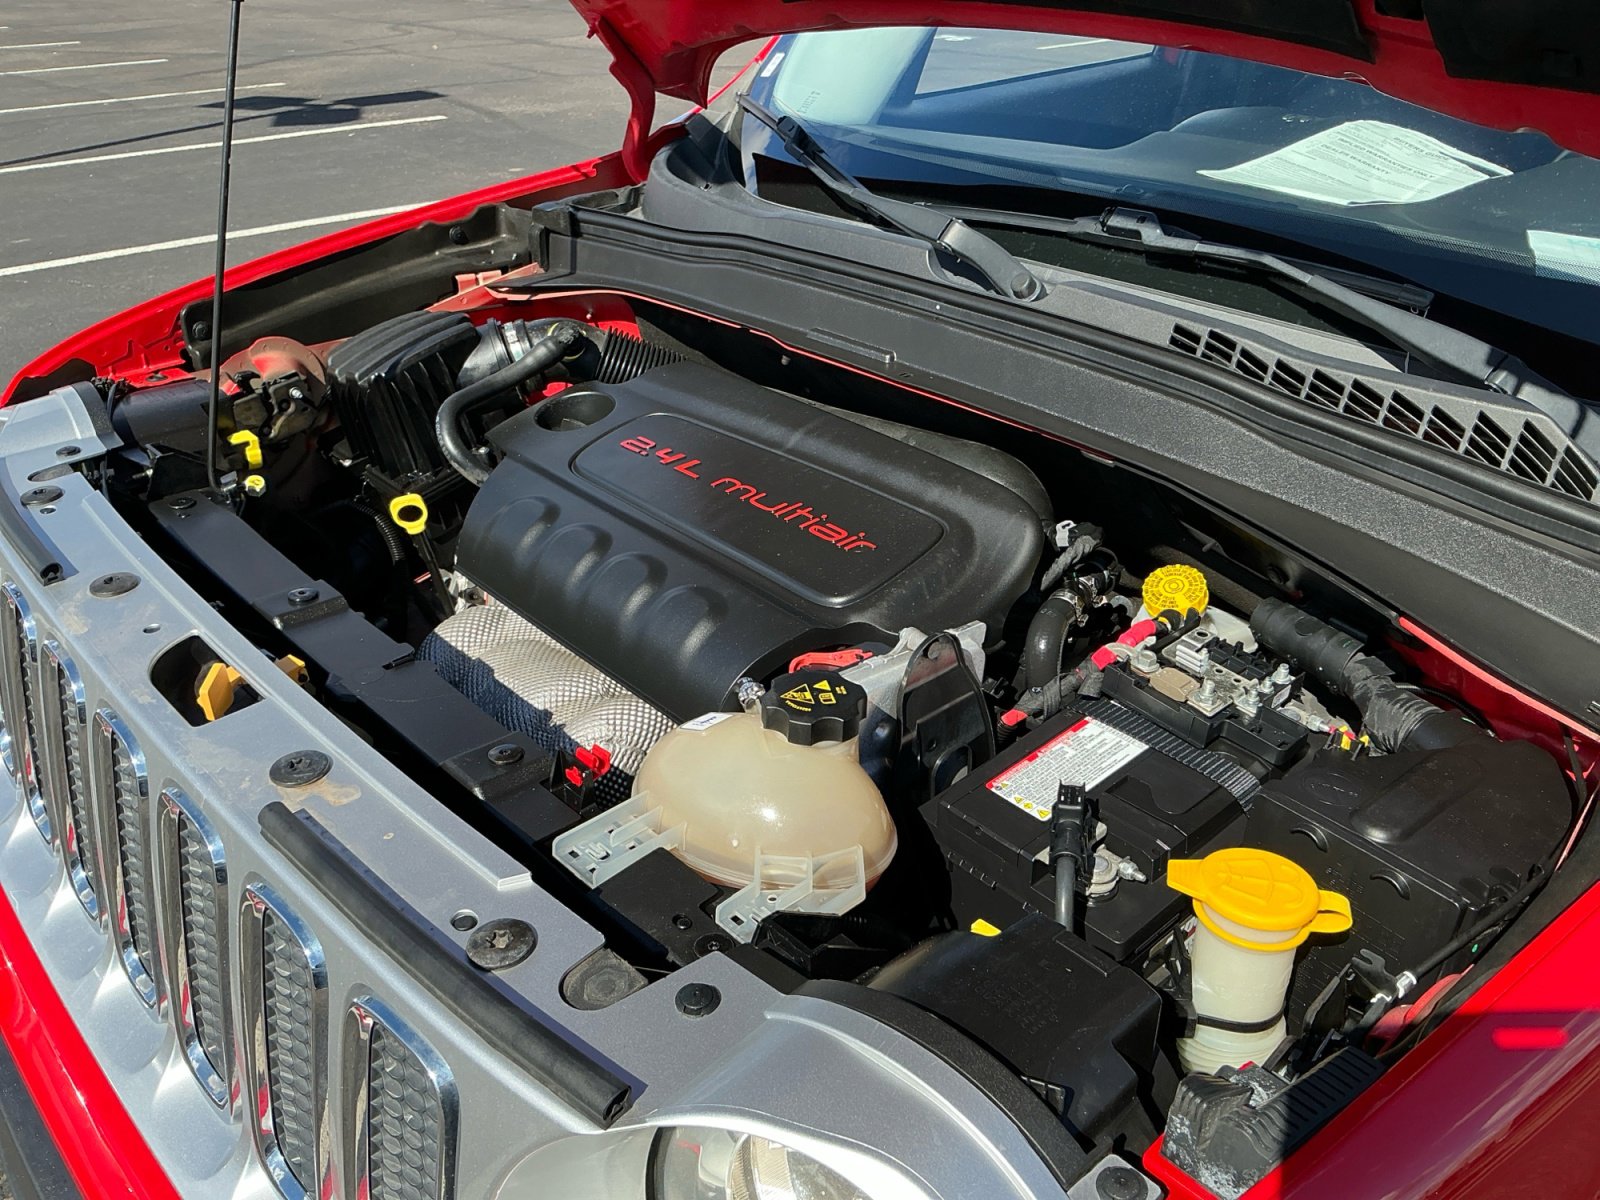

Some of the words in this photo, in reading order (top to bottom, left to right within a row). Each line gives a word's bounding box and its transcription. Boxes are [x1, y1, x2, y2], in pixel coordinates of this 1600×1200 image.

[1321, 143, 1349, 157] DEALER
[1349, 154, 1390, 175] WARRANTY
[1338, 138, 1366, 152] IMPLIED
[1366, 149, 1412, 171] WARRANTIES
[1413, 169, 1435, 179] ONLY
[619, 435, 701, 479] 2.4L
[711, 477, 877, 552] multiair
